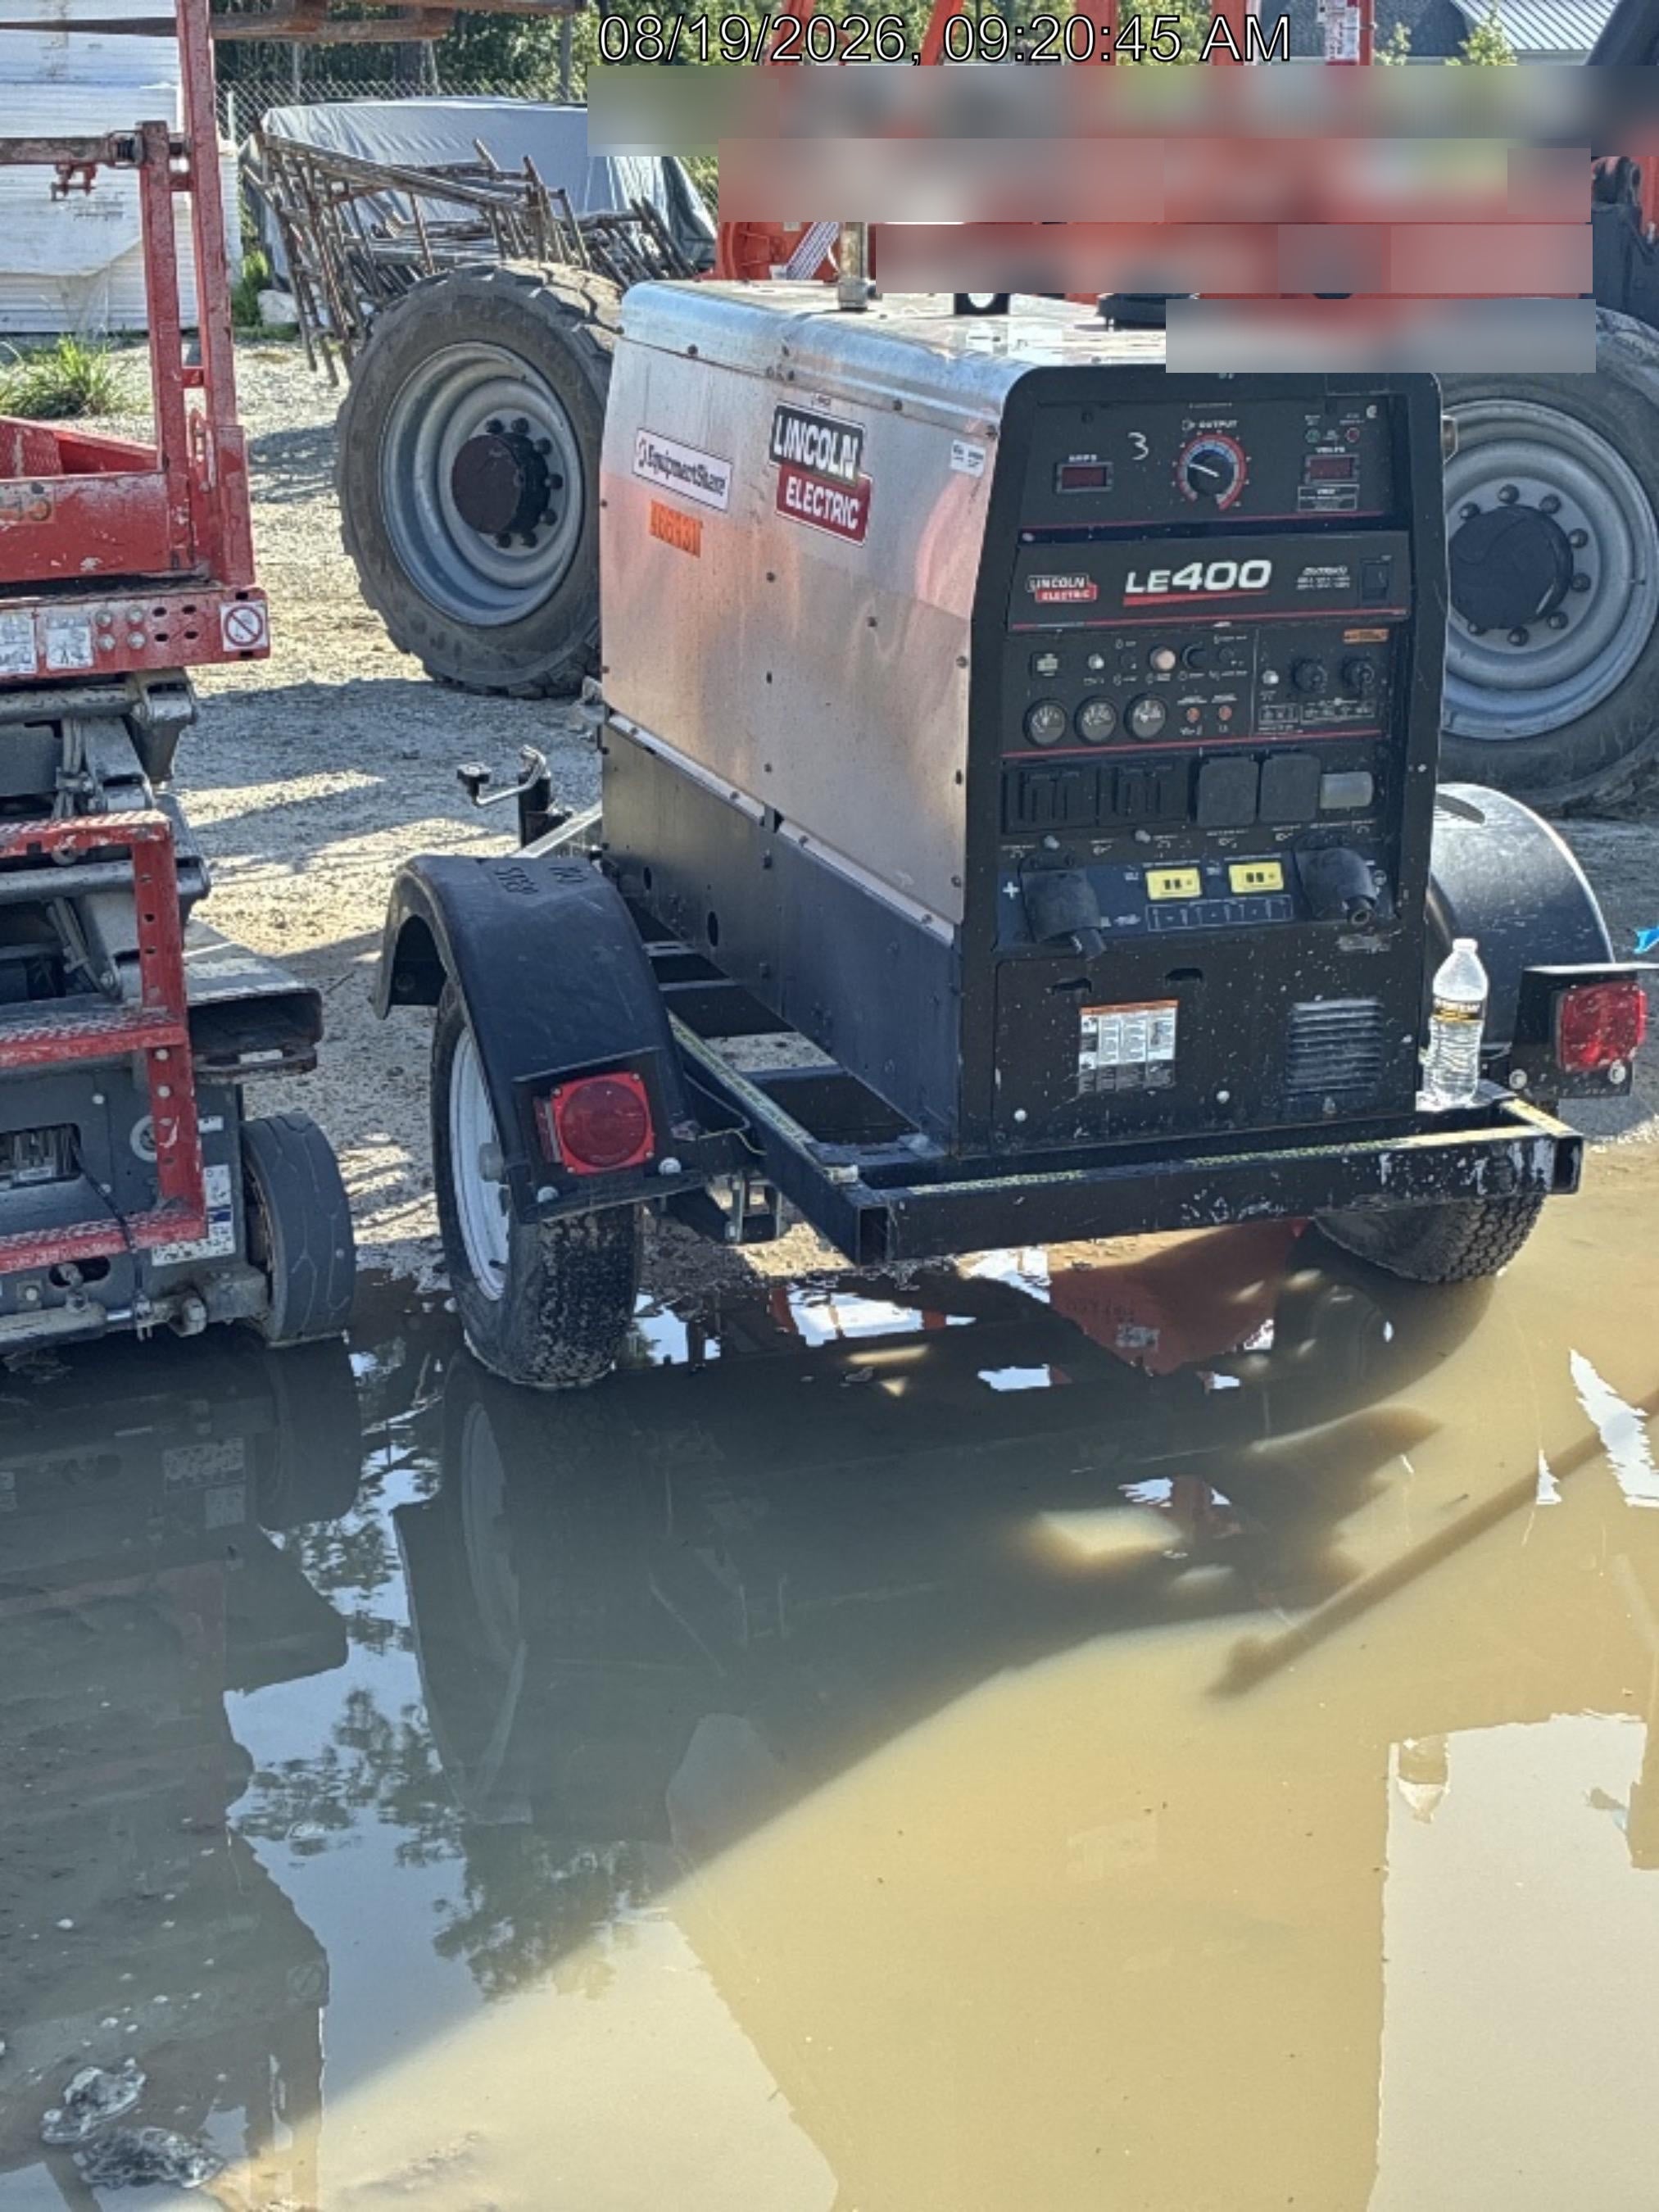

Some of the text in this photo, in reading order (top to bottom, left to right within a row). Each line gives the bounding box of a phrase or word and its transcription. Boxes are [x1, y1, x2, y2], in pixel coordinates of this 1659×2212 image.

[773, 414, 859, 480] LINCOLN
[1127, 431, 1149, 461] 3
[785, 477, 859, 530] ELECTRIC
[1029, 575, 1088, 589] LINCOLN
[1124, 559, 1271, 593] LE400
[1040, 589, 1090, 601] ELECTRIC
